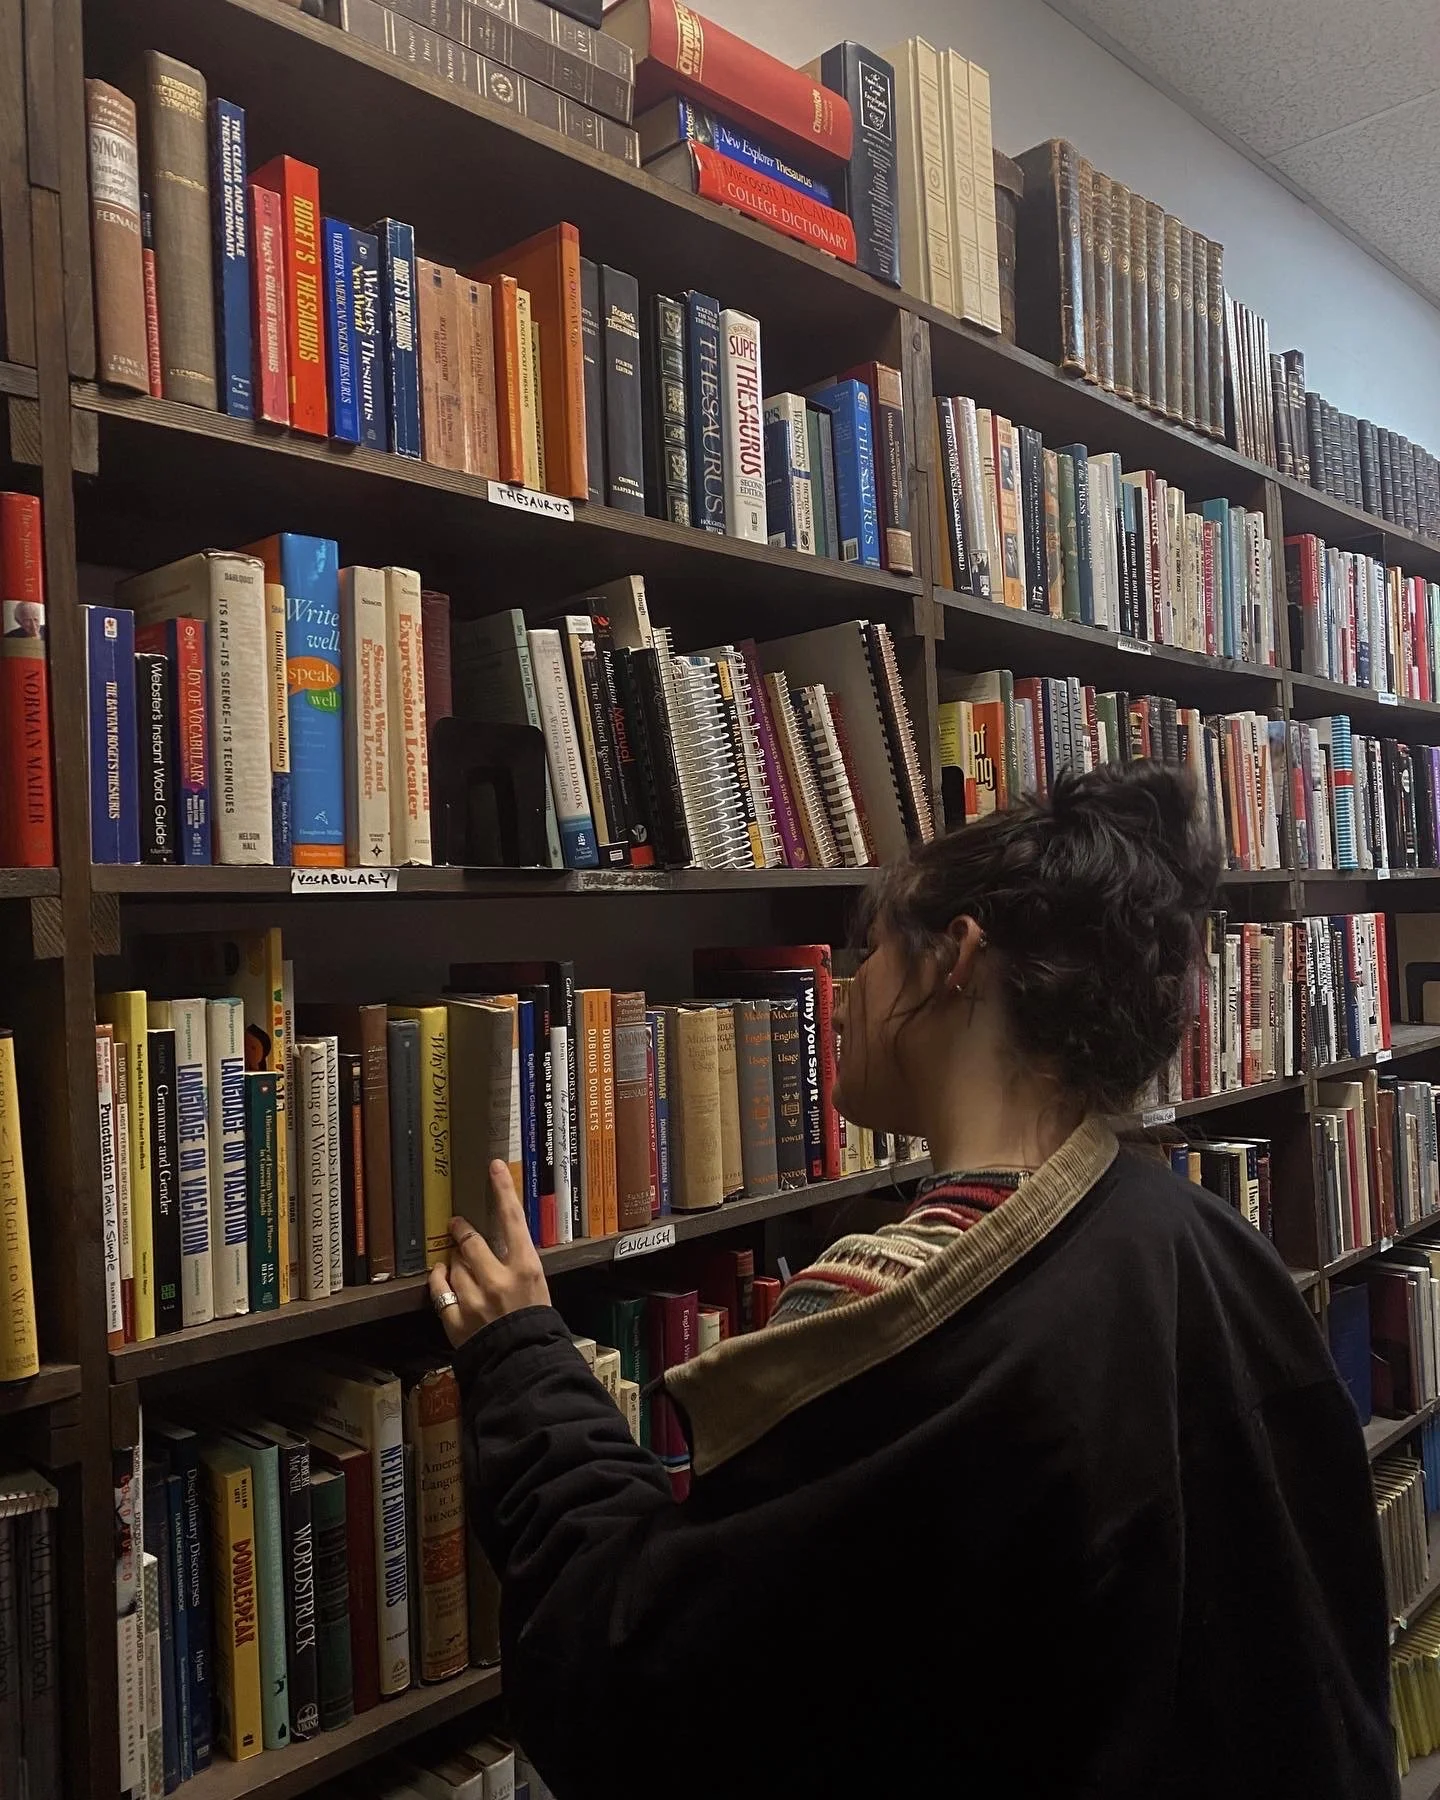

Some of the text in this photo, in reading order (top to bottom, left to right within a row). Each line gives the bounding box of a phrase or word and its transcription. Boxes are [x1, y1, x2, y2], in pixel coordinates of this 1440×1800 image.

[221, 115, 236, 260] THESAURUS DICTIONARY
[231, 120, 246, 257] THE CLEAR AND SIMPLE
[721, 127, 813, 188] New Explorer Thesaurus
[722, 161, 846, 232] Microsoft ENCARTA
[727, 183, 848, 250] COLLEGE DICTIONARY
[262, 225, 280, 373] Roget's COLLEGE THESAURUS
[293, 195, 320, 364] ROGET'S THESAURUS
[333, 232, 353, 405] WEBSTER'S AMERICAN ENGLISH THESAURUS
[352, 262, 368, 334] New World
[362, 269, 381, 336] Webster's
[393, 256, 413, 352] ROGET'S THESAURUS
[361, 339, 378, 422] Thesaurus
[699, 336, 725, 514] THESAURUS
[736, 364, 762, 479] THESAURUS
[740, 478, 764, 491] SECOND
[793, 410, 807, 469] WEBSTER'S
[857, 422, 874, 546] THESAURUS
[1077, 459, 1087, 515] of the PRESS
[497, 487, 570, 515] THESAURUS
[740, 487, 764, 499] EDITION
[803, 482, 811, 531] DICTIONARY
[1132, 580, 1140, 618] BATTLEFIELD
[1151, 499, 1161, 613] BAKER TIMES
[286, 598, 340, 627] Write
[186, 665, 203, 689] JOY
[188, 690, 202, 706] OF
[288, 664, 335, 685] speak
[309, 691, 337, 709] well
[360, 638, 375, 801] Expression Locater
[398, 613, 420, 821] Expression Locater
[603, 650, 619, 705] Publication
[613, 706, 637, 764] Manual
[23, 671, 45, 825] NORMAN MAILER
[105, 681, 121, 820] THE BANTAM ROGET'S THESAURUS
[149, 661, 167, 846] Webster's Instant Word Guide
[189, 706, 205, 785] VOCABULARY
[375, 711, 387, 760] Word
[376, 761, 387, 793] and
[590, 680, 614, 782] The Bedford Reader
[728, 704, 757, 819] THE HALF-KNOWN WORLD
[297, 872, 391, 889] VOCABULARY
[543, 1051, 555, 1081] English
[587, 1028, 599, 1131] DUBIOUS DOUBLETS
[602, 1028, 613, 1074] DUBIOUS
[773, 1030, 799, 1044] English
[777, 1053, 799, 1065] Usage
[429, 1032, 449, 1177] Why Do We Say It?
[544, 1101, 556, 1128] global
[545, 1082, 553, 1093] as
[568, 1037, 579, 1166] PASSWORDS TO PEOPLE
[603, 1077, 614, 1131] DOUBLETS
[656, 1015, 669, 1184] ACTIONGRAMMAR JOANNE FEIERMAN
[100, 1102, 118, 1272] Punctuation Plain & Simple
[156, 1084, 172, 1216] Grammar and Gender
[177, 1062, 209, 1256] LANGUAGE ON VACATION
[220, 1057, 248, 1246] LANGUAGE ON VACATION
[308, 1050, 327, 1290] A Ring of Words IVOR BROWN
[326, 1043, 341, 1270] RANDOM WORDS IVOR BROWN
[545, 1128, 556, 1166] language
[781, 1134, 804, 1144] FOWLER
[2, 1158, 32, 1346] The RIGHT to WRITE
[619, 1229, 670, 1255] ENGLISH
[300, 1453, 311, 1488] ROBERT
[439, 1439, 457, 1454] The
[174, 1512, 185, 1613] PLAIN ENGLISH HANDBOOK
[380, 1443, 407, 1608] NEVER ENOUGH WORDS
[30, 1534, 55, 1700] MLA Handbook
[185, 1467, 206, 1683] Disciplinary Discourses Hyland
[233, 1537, 255, 1649] DOUBLESPEAK
[291, 1521, 316, 1655] WORDSTRUCK
